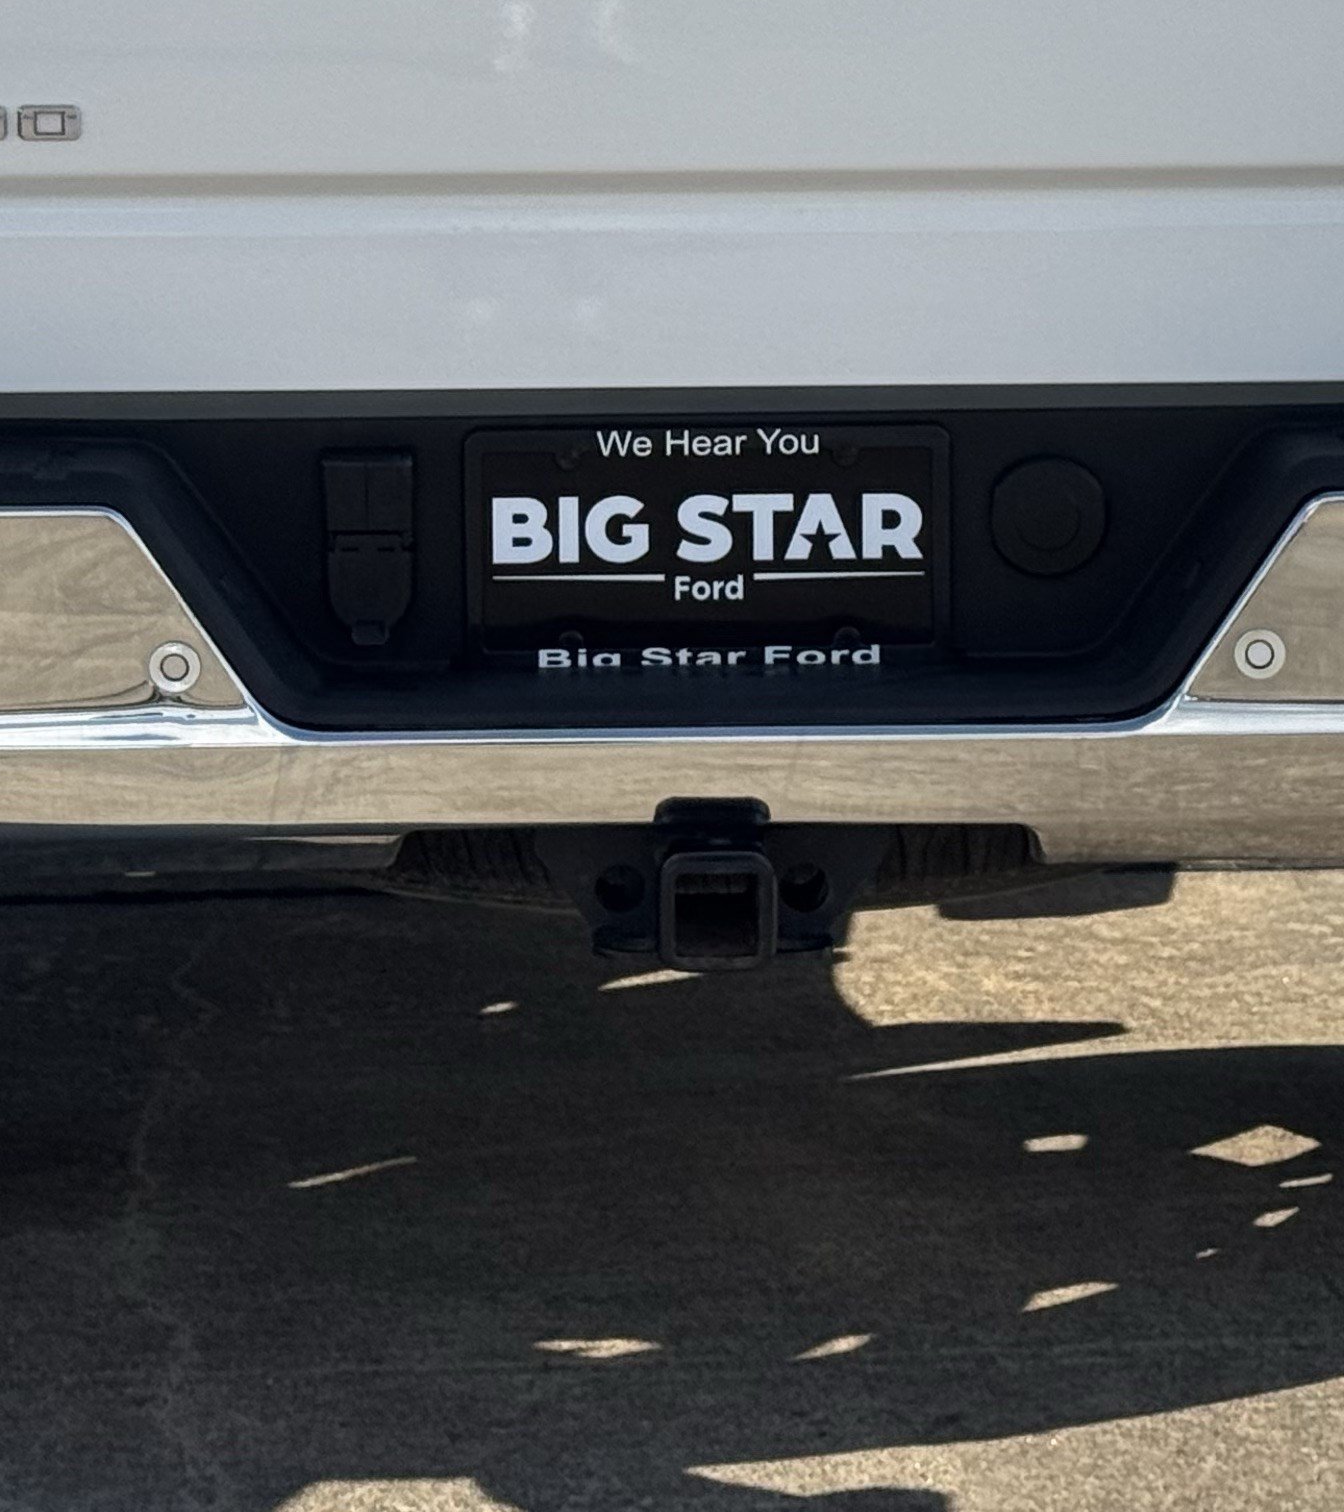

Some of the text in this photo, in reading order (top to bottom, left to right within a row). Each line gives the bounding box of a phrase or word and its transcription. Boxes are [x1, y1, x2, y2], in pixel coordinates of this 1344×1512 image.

[596, 428, 820, 457] We Hear You
[491, 492, 924, 565] BIG STAR
[674, 574, 745, 601] Ford
[538, 644, 881, 669] Big Star Ford
